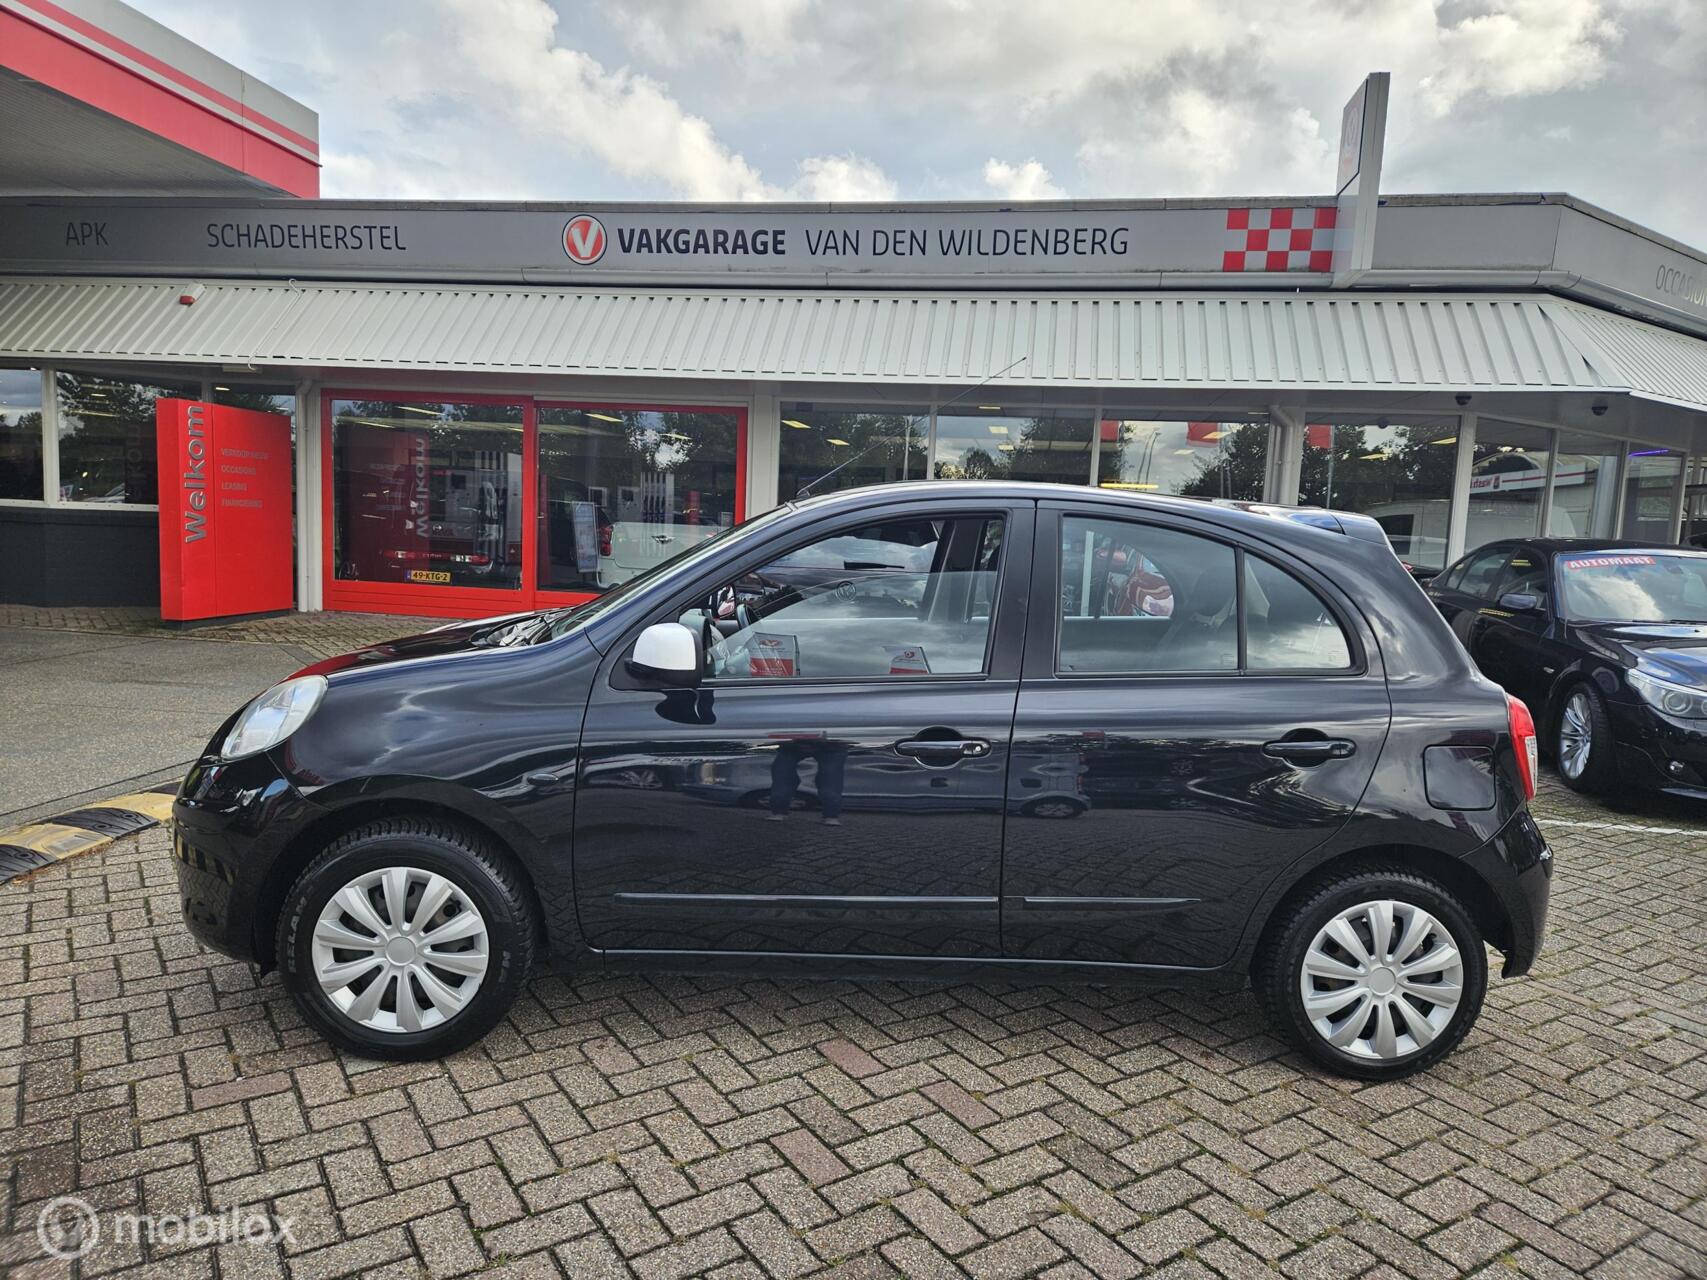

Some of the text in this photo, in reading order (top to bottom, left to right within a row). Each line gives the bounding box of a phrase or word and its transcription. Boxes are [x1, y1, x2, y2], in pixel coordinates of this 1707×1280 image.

[65, 221, 109, 247] APK
[206, 223, 406, 251] SCHADEHERSTEL
[617, 227, 1129, 256] VAKGARAGE VAN DEN WILDENBERG
[184, 405, 208, 543] Welkom
[412, 571, 449, 581] 49-KTG-2
[1569, 556, 1652, 569] AUTOMAAT
